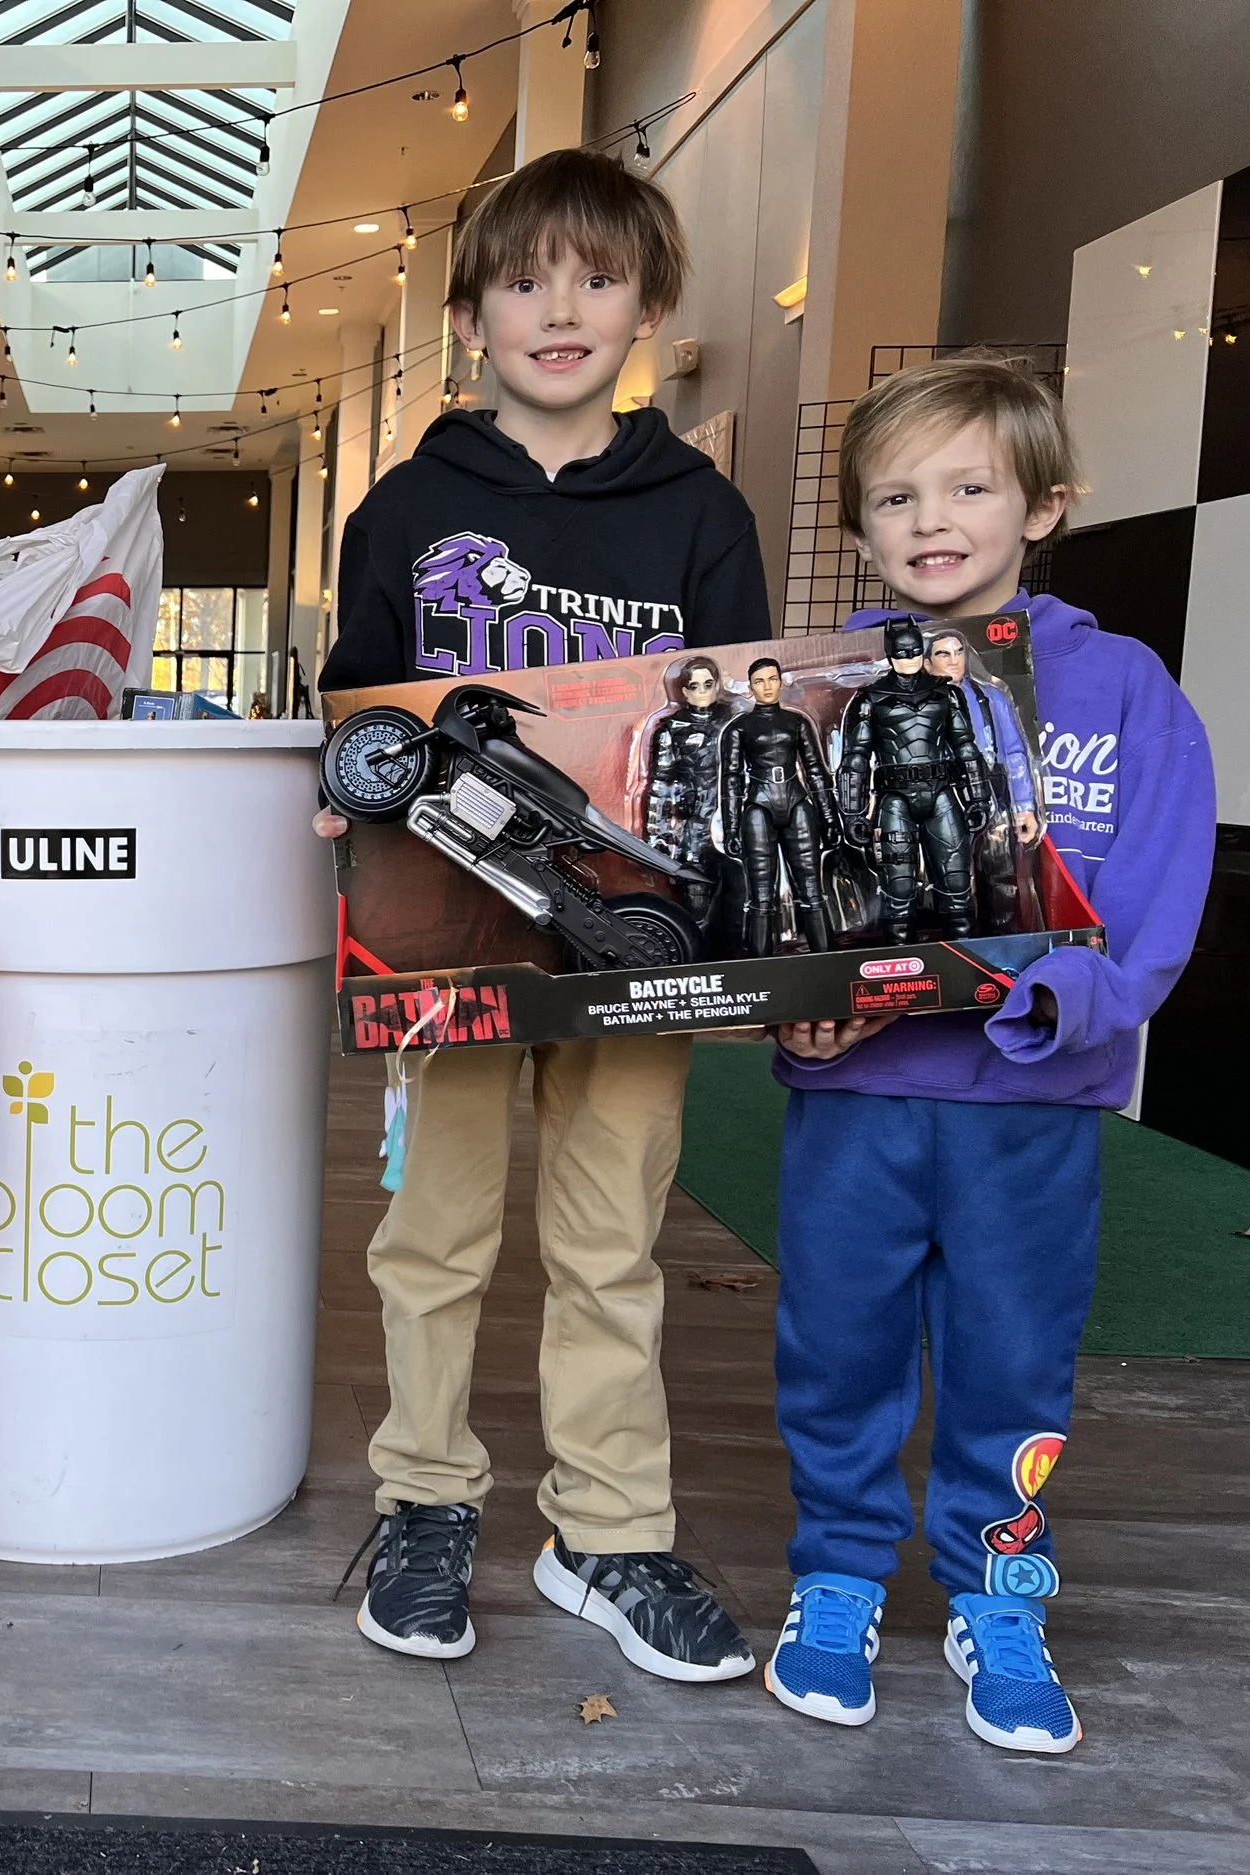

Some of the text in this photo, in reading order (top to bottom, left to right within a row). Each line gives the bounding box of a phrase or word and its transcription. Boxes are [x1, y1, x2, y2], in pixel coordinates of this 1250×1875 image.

[415, 596, 685, 676] LION
[989, 622, 1016, 641] DC
[1043, 776, 1115, 813] ERE
[8, 837, 128, 871] ULINE
[864, 963, 908, 975] ONLY AT
[420, 978, 435, 989] THE
[882, 980, 937, 993] WARNING:
[588, 1003, 630, 1015] BRUCE
[690, 993, 734, 1007] SELINA
[669, 1010, 692, 1021] THE
[69, 1095, 207, 1174] the
